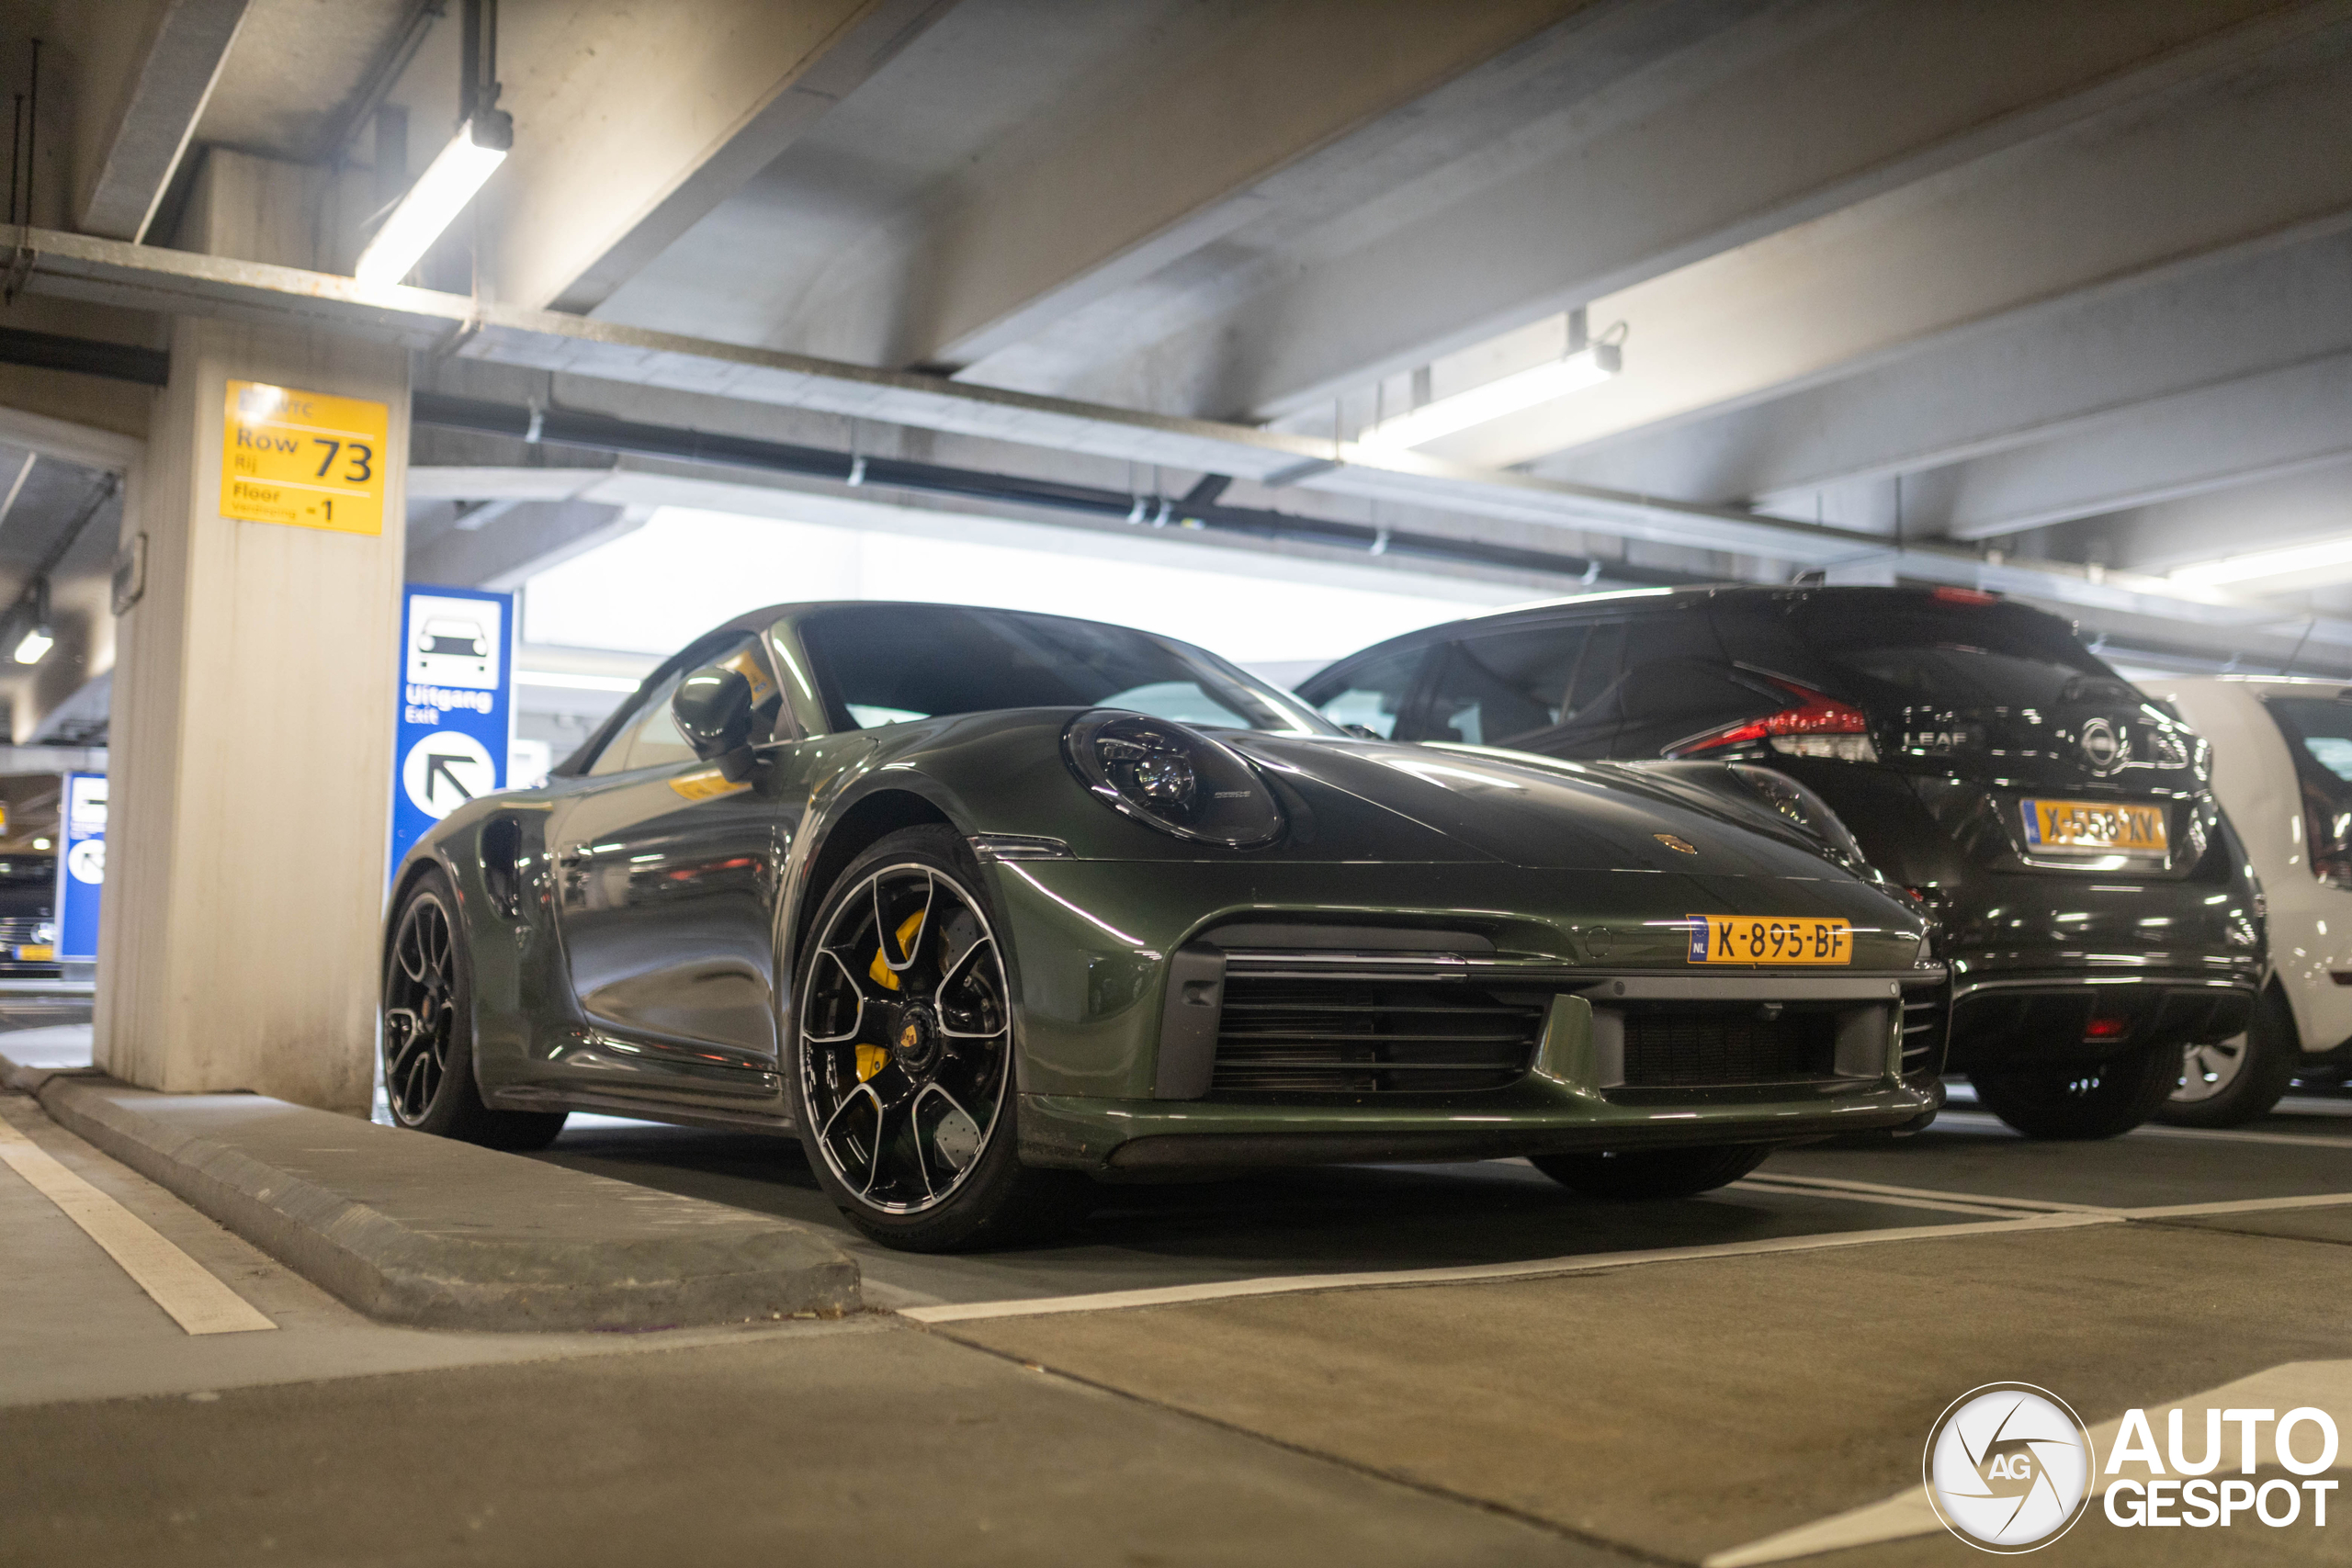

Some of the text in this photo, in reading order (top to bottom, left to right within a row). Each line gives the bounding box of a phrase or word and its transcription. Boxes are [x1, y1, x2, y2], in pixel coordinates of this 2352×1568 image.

[235, 454, 256, 473] Rij
[237, 427, 372, 482] Row 73
[233, 482, 279, 502] Floor
[406, 683, 493, 715] Uitgang
[405, 705, 440, 726] Exit
[1903, 732, 1966, 746] LEAF
[1693, 942, 1705, 953] NL
[1718, 922, 1843, 958] K-895-BF
